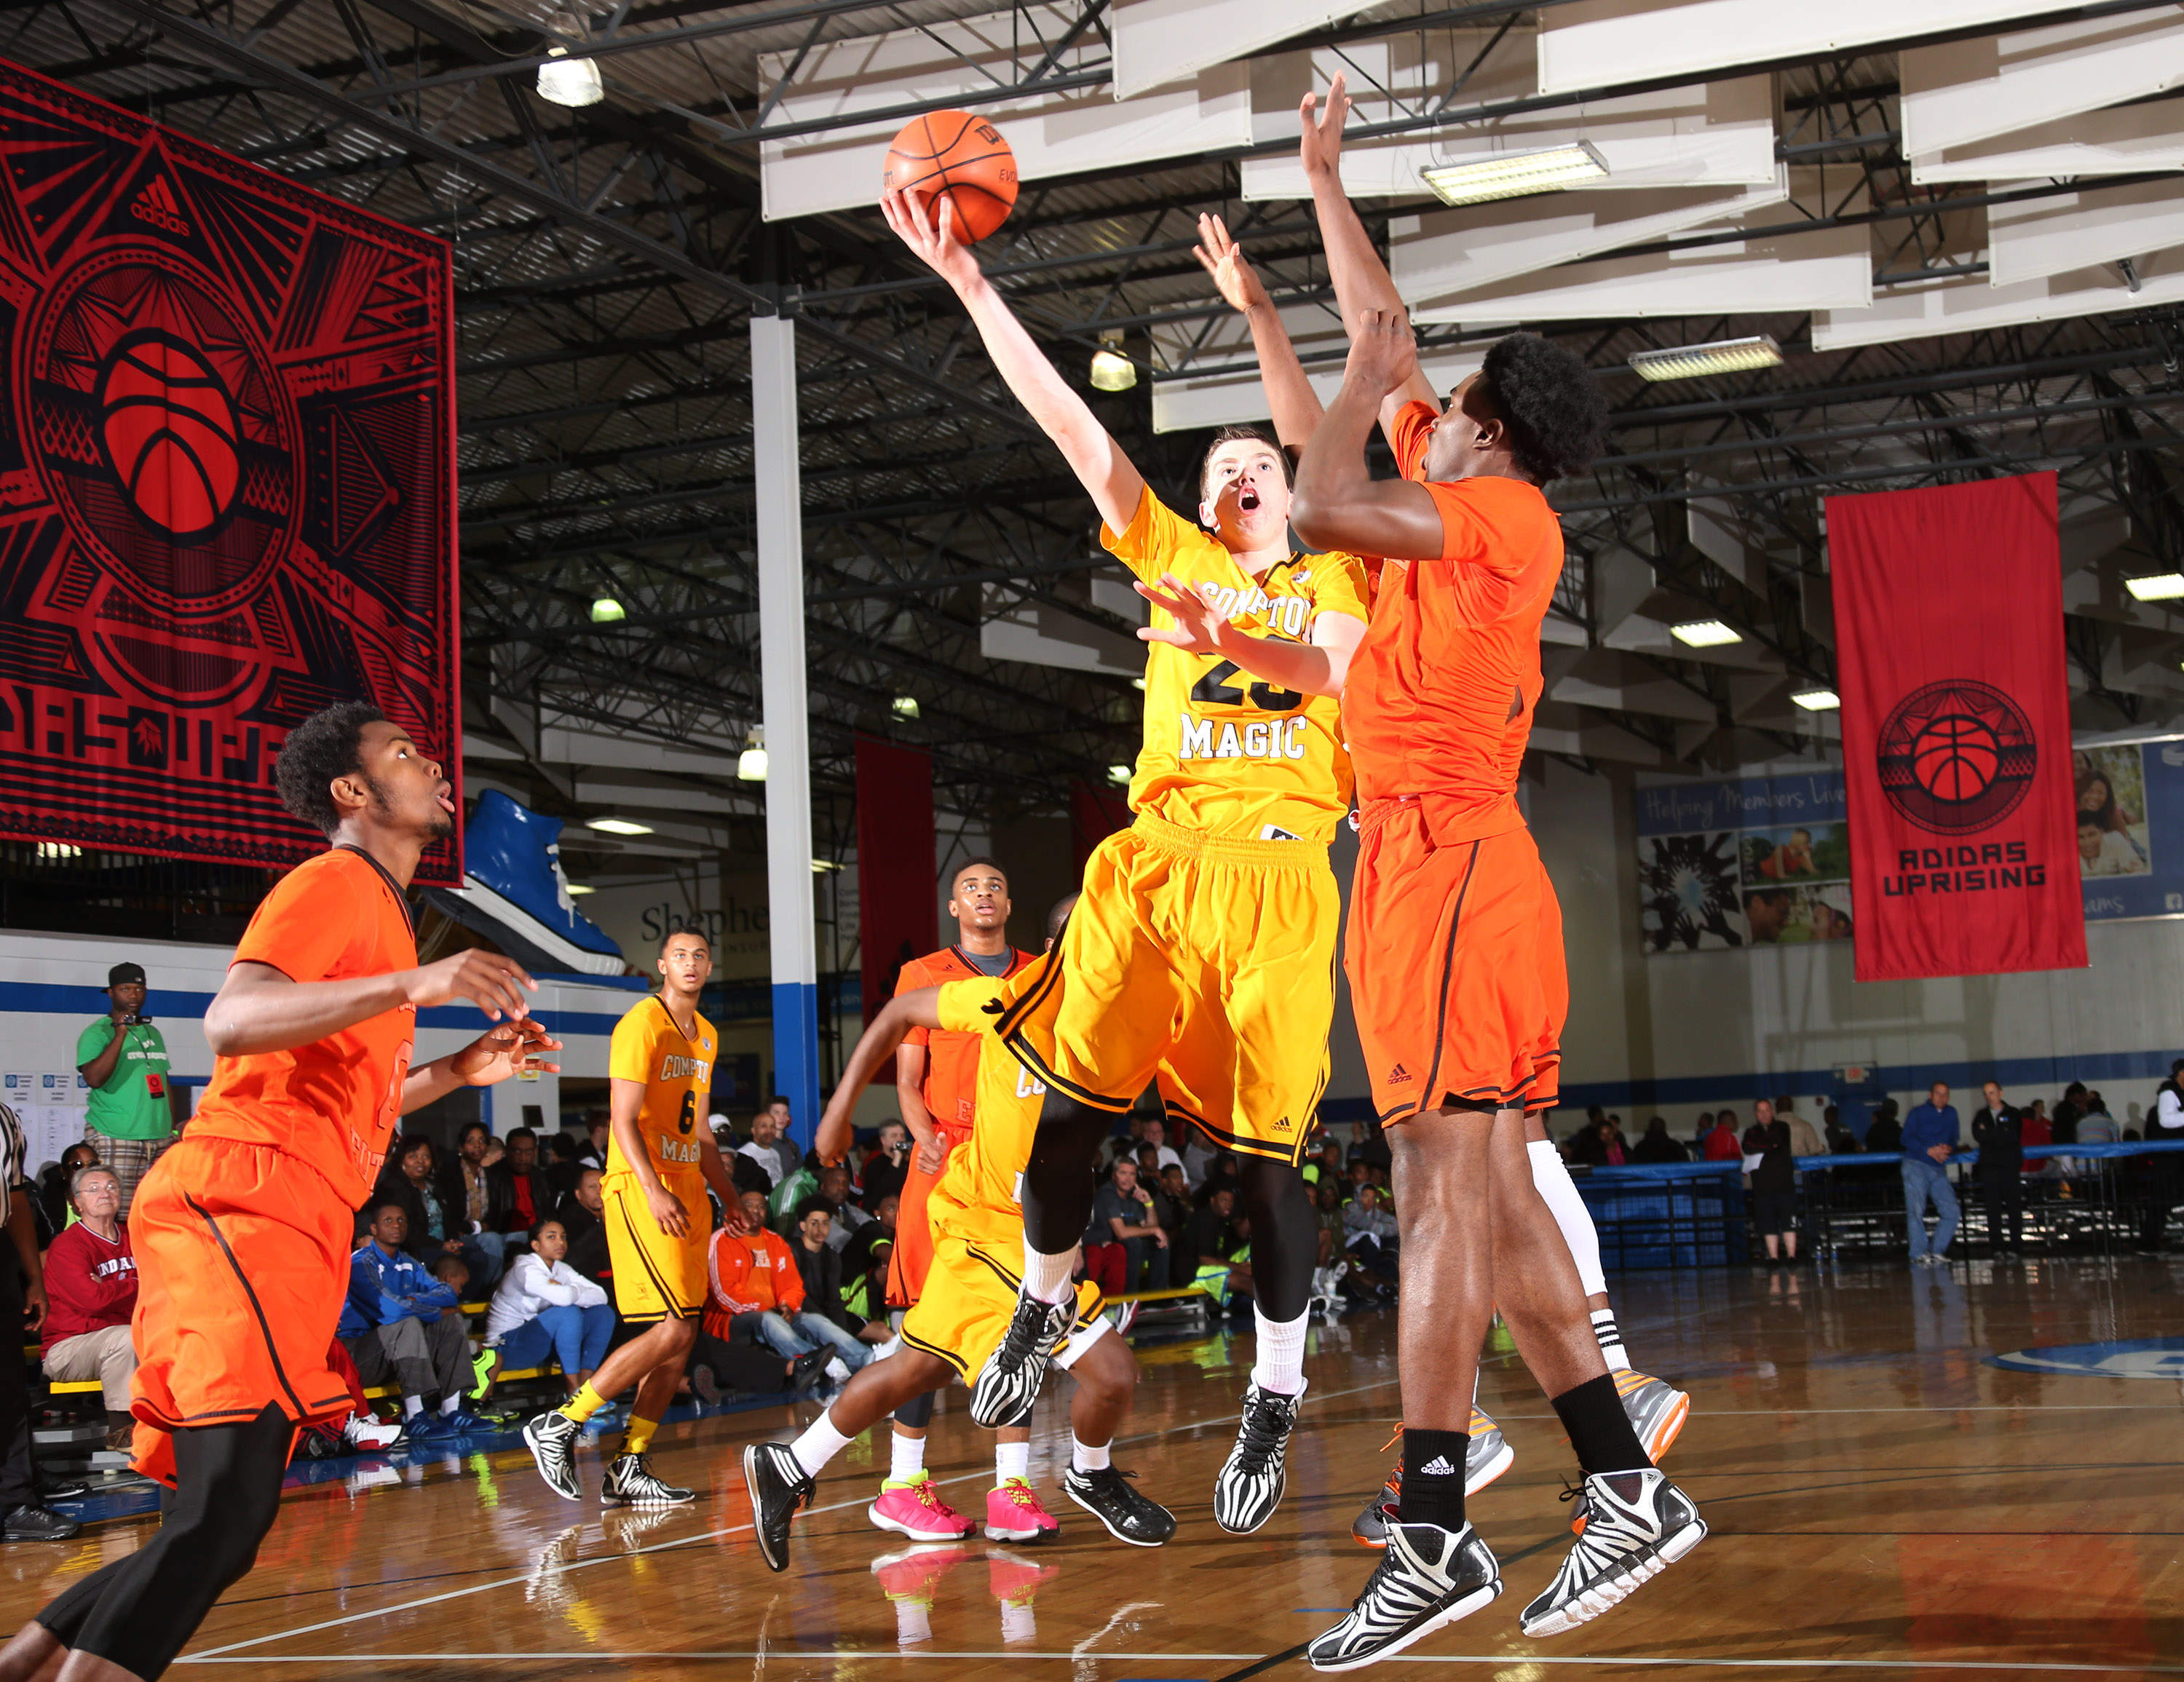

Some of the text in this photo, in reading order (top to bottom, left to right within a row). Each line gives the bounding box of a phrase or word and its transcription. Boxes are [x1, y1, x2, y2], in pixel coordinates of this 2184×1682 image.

[130, 202, 191, 238] adidas
[1179, 713, 1307, 760] MAGIC
[1645, 789, 1714, 829] Helping
[1719, 783, 1805, 813] Members
[1899, 842, 2027, 870] ADIDAS
[1884, 865, 2046, 897] UPRISING
[678, 1090, 695, 1135] 6
[1420, 1464, 1455, 1475] adidas
